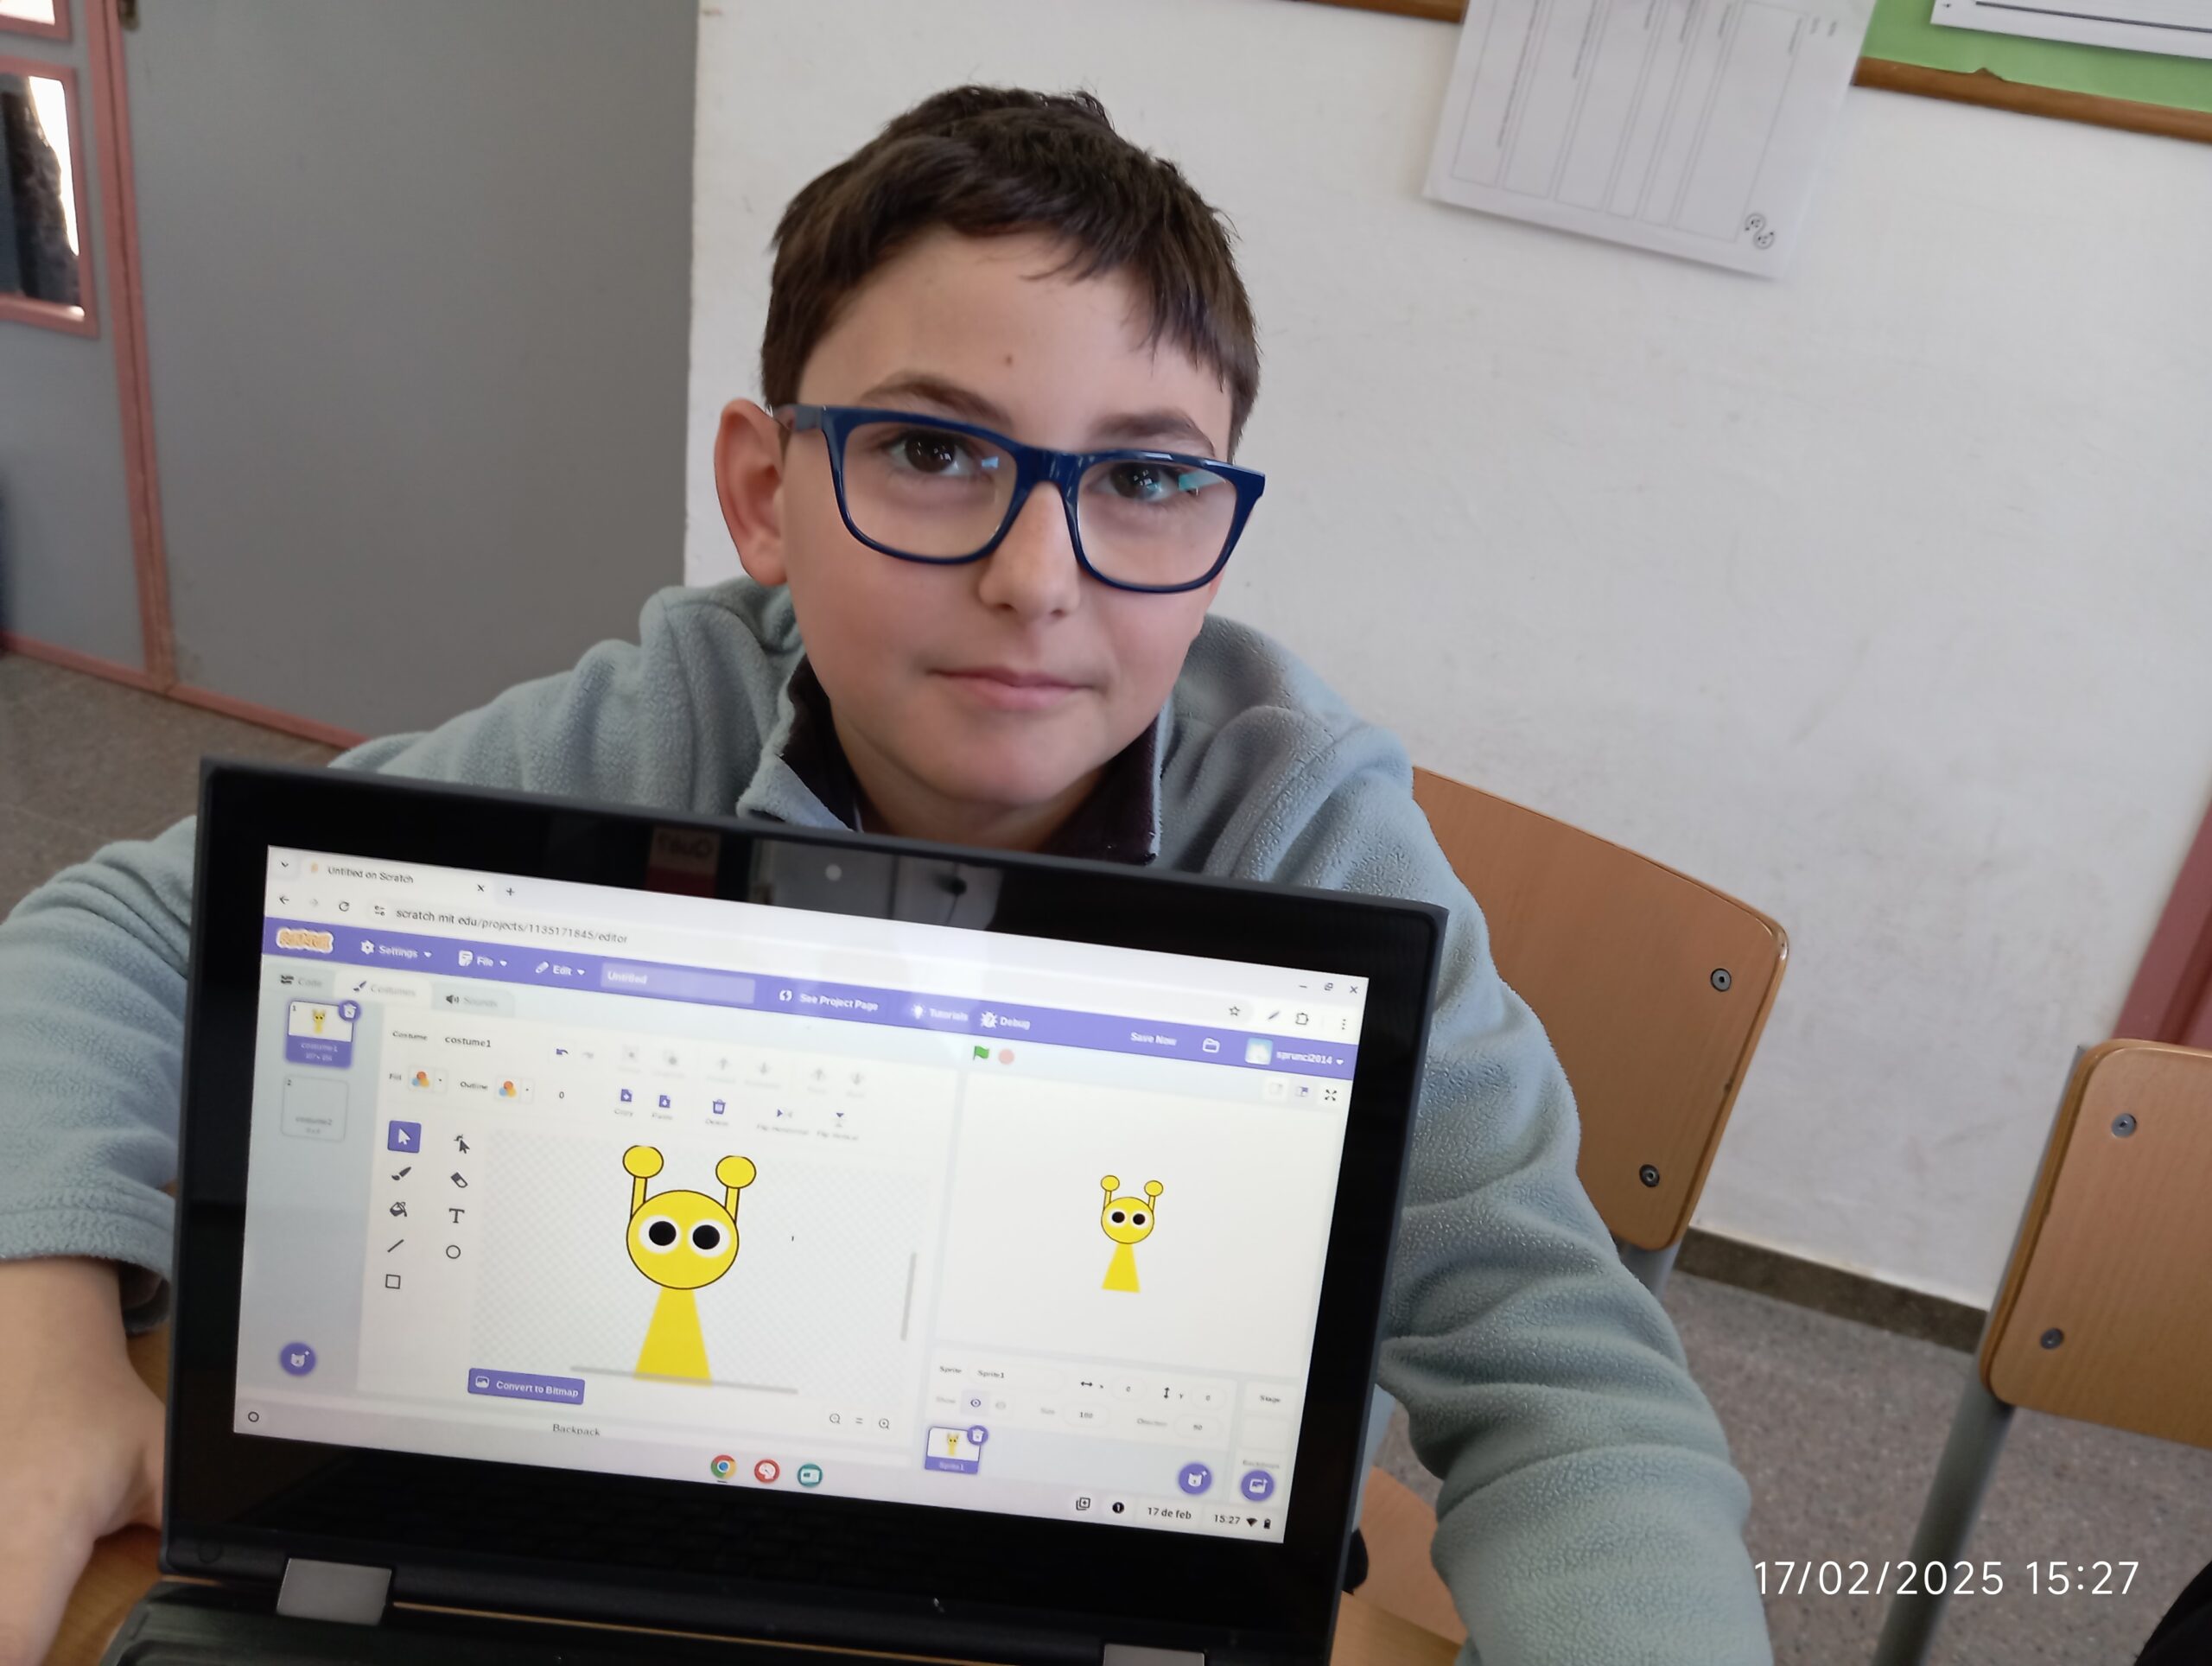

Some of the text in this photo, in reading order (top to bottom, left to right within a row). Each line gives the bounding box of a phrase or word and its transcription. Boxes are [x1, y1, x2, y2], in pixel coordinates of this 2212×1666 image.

[327, 866, 363, 878] Untitled
[379, 871, 414, 883] Scratch
[396, 909, 628, 944] scratchmitedu/projects/1135171845/editor
[378, 944, 419, 959] Settings
[477, 955, 494, 967] File
[552, 963, 573, 976] Edit
[607, 970, 648, 986] Untitled
[799, 993, 879, 1012] See Project Page
[1000, 1015, 1031, 1030] Debug
[392, 1030, 429, 1042] Costume
[444, 1035, 492, 1048] costume1
[1130, 1032, 1178, 1046] Save Now
[496, 1380, 579, 1398] Convert to Bitmap
[552, 1423, 601, 1437] Backpack
[1147, 1506, 1192, 1520] 17 de feb
[1214, 1514, 1241, 1525] 15:27
